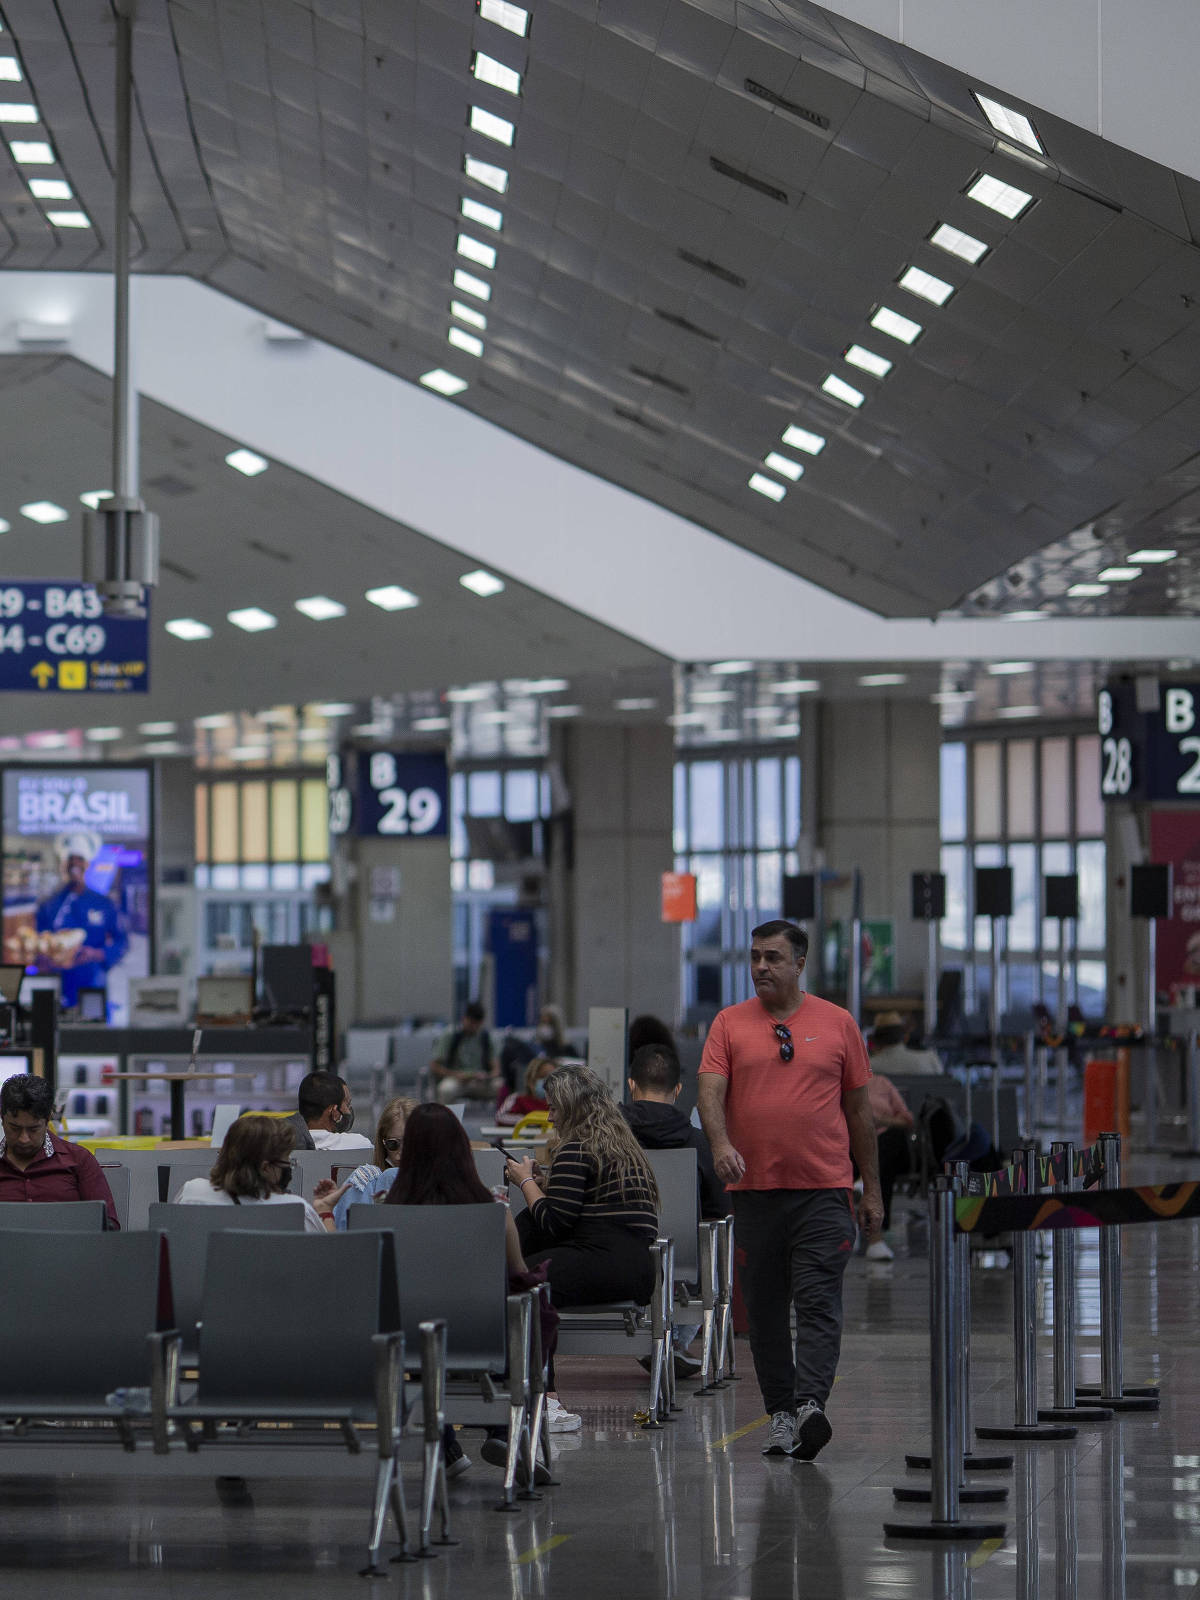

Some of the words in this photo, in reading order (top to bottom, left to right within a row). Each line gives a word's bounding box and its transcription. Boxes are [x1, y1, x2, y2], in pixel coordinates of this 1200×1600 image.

[45, 587, 103, 619] B43
[45, 623, 106, 654] C69
[1099, 690, 1112, 735] B
[1166, 689, 1194, 733] B
[370, 752, 397, 790] B
[1103, 737, 1132, 794] 28
[1177, 736, 1200, 793] 2
[19, 791, 138, 822] BRASIL
[378, 786, 441, 834] 29
